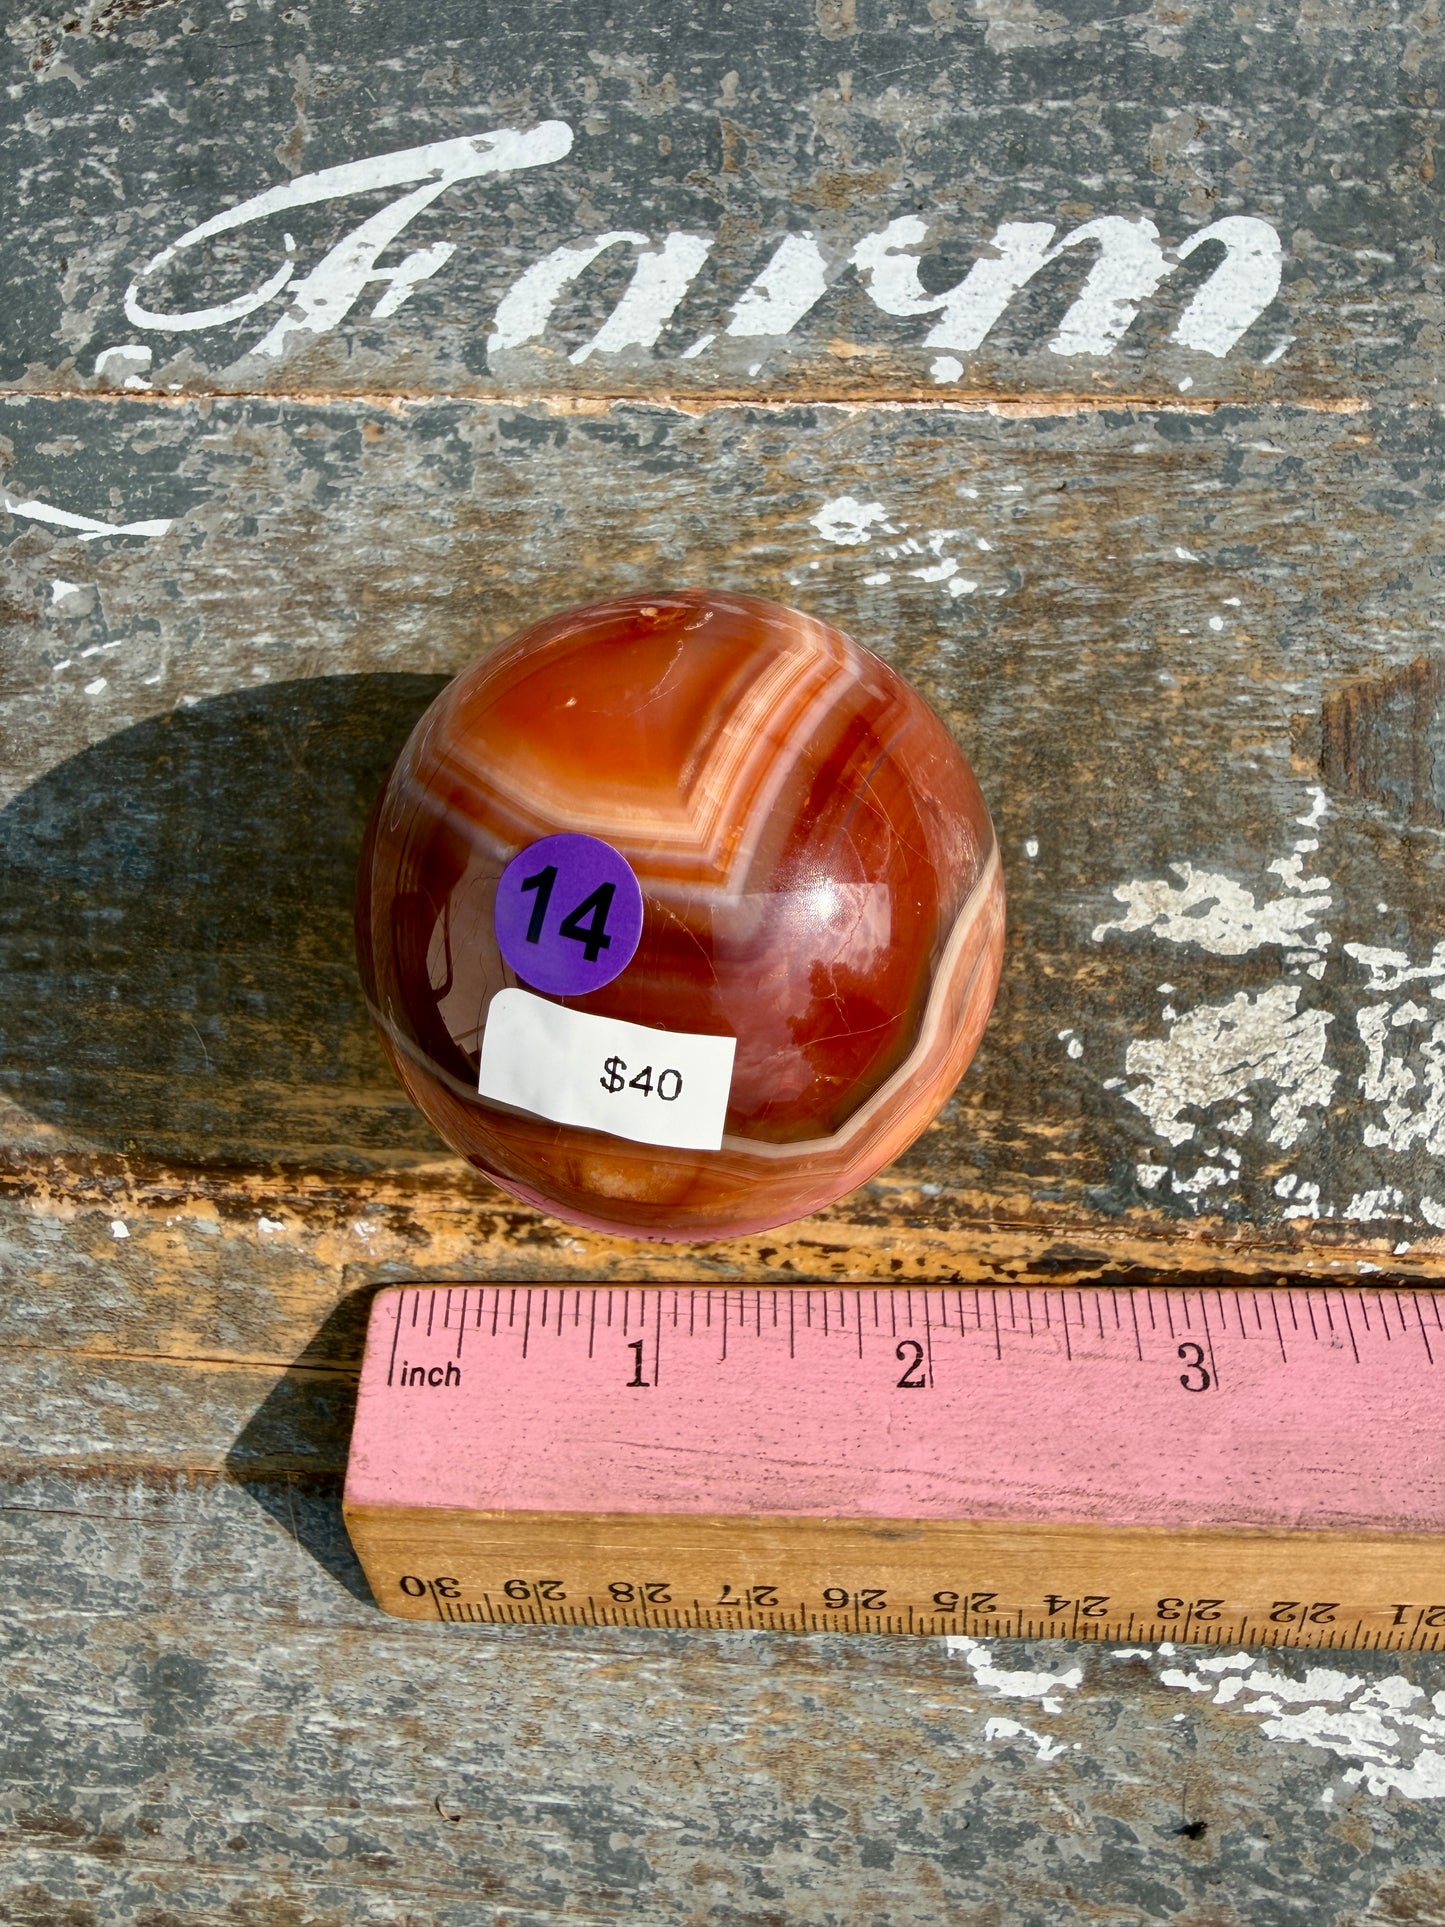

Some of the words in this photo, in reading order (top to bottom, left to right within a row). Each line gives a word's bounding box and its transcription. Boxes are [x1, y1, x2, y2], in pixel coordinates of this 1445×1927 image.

[95, 119, 1297, 388] Farm
[520, 865, 617, 963] 14
[599, 1055, 683, 1102] $40
[400, 1361, 461, 1387] inch
[625, 1339, 651, 1388] 1
[896, 1340, 926, 1388] 2
[1177, 1342, 1211, 1392] 3
[400, 1574, 463, 1599] 30
[503, 1578, 567, 1601] 29
[607, 1581, 671, 1604] 28
[716, 1584, 779, 1606] 27
[823, 1587, 888, 1611] 26
[932, 1591, 998, 1614] 25
[1043, 1594, 1110, 1617] 24
[1156, 1597, 1225, 1620] 23
[1268, 1601, 1341, 1624] 22
